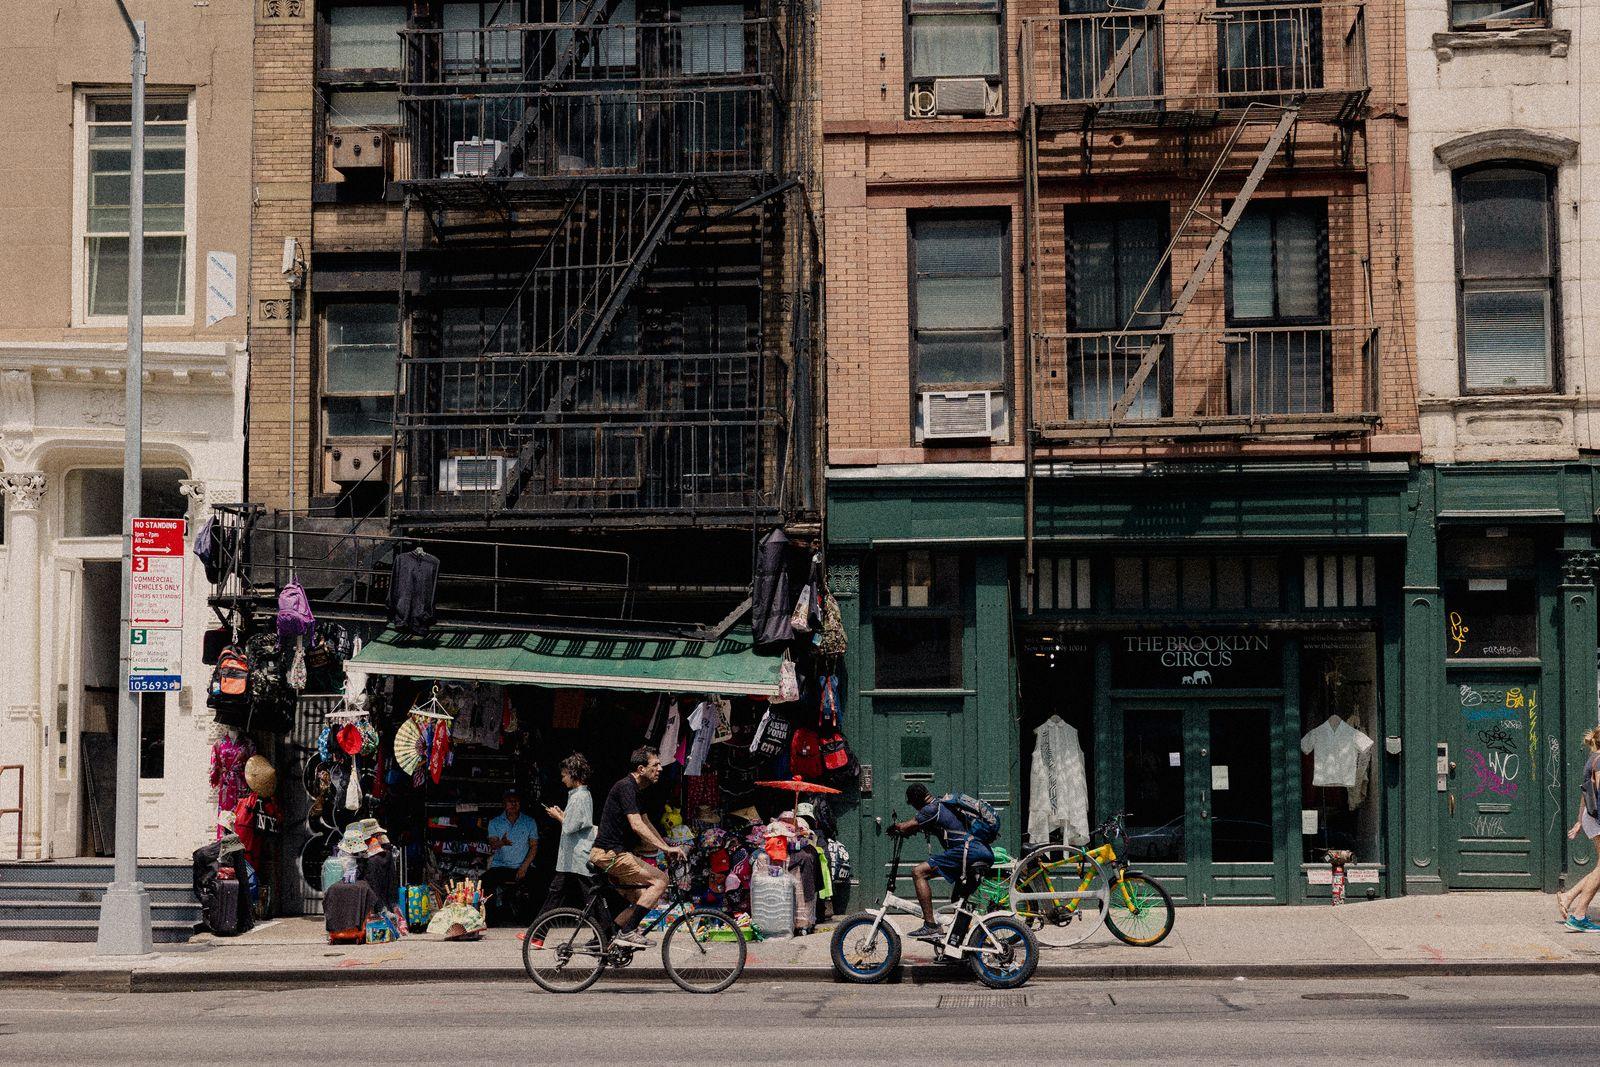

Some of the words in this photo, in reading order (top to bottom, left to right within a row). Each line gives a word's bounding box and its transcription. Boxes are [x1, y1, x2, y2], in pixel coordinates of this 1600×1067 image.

[145, 521, 177, 529] STANDING
[136, 557, 145, 571] 3
[133, 629, 144, 643] 5
[1123, 636, 1164, 652] THE
[1167, 635, 1269, 651] BROOKLYN
[1160, 651, 1233, 667] CIRCUS
[130, 681, 169, 690] 105693
[770, 721, 789, 732] NEW
[766, 727, 788, 740] YORK
[760, 742, 782, 755] CITY
